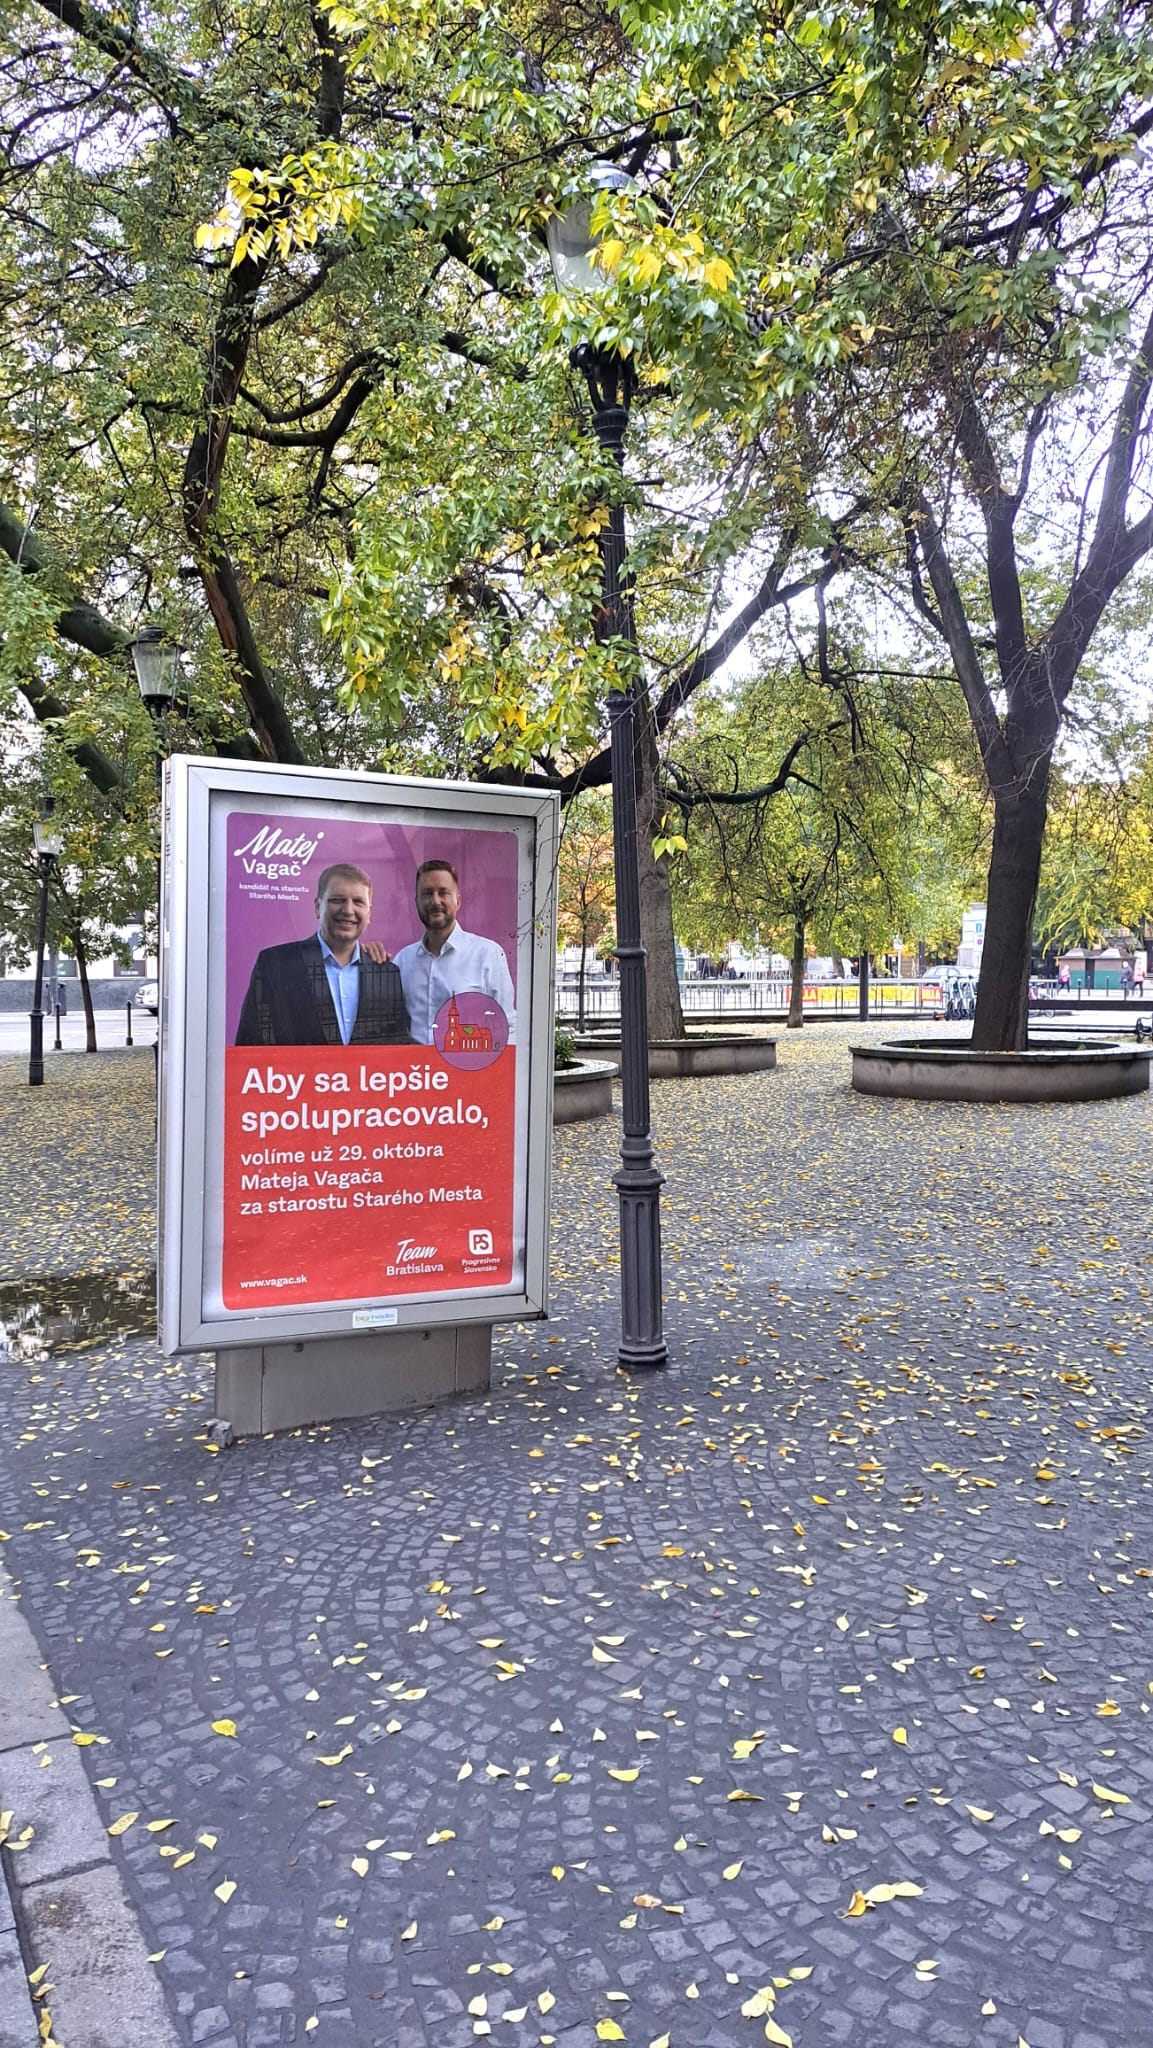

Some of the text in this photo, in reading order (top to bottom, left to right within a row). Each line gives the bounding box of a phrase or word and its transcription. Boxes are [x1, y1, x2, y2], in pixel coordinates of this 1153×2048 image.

[234, 825, 324, 865] Matej
[242, 858, 302, 879] Vagač
[277, 893, 300, 901] Mesta
[281, 885, 310, 893] starostu
[241, 1064, 449, 1100] Aby sa lepšie
[241, 1098, 489, 1138] spolupracovalo,
[240, 1142, 444, 1166] volíme už 29. októbra
[241, 1168, 383, 1192] Mateja Vagača
[240, 1185, 483, 1215] za starostu Starého Mesta
[395, 1238, 438, 1264] Team
[472, 1233, 490, 1251] PS
[240, 1274, 308, 1289] www.vagac.sk
[386, 1263, 444, 1276] Bratislava
